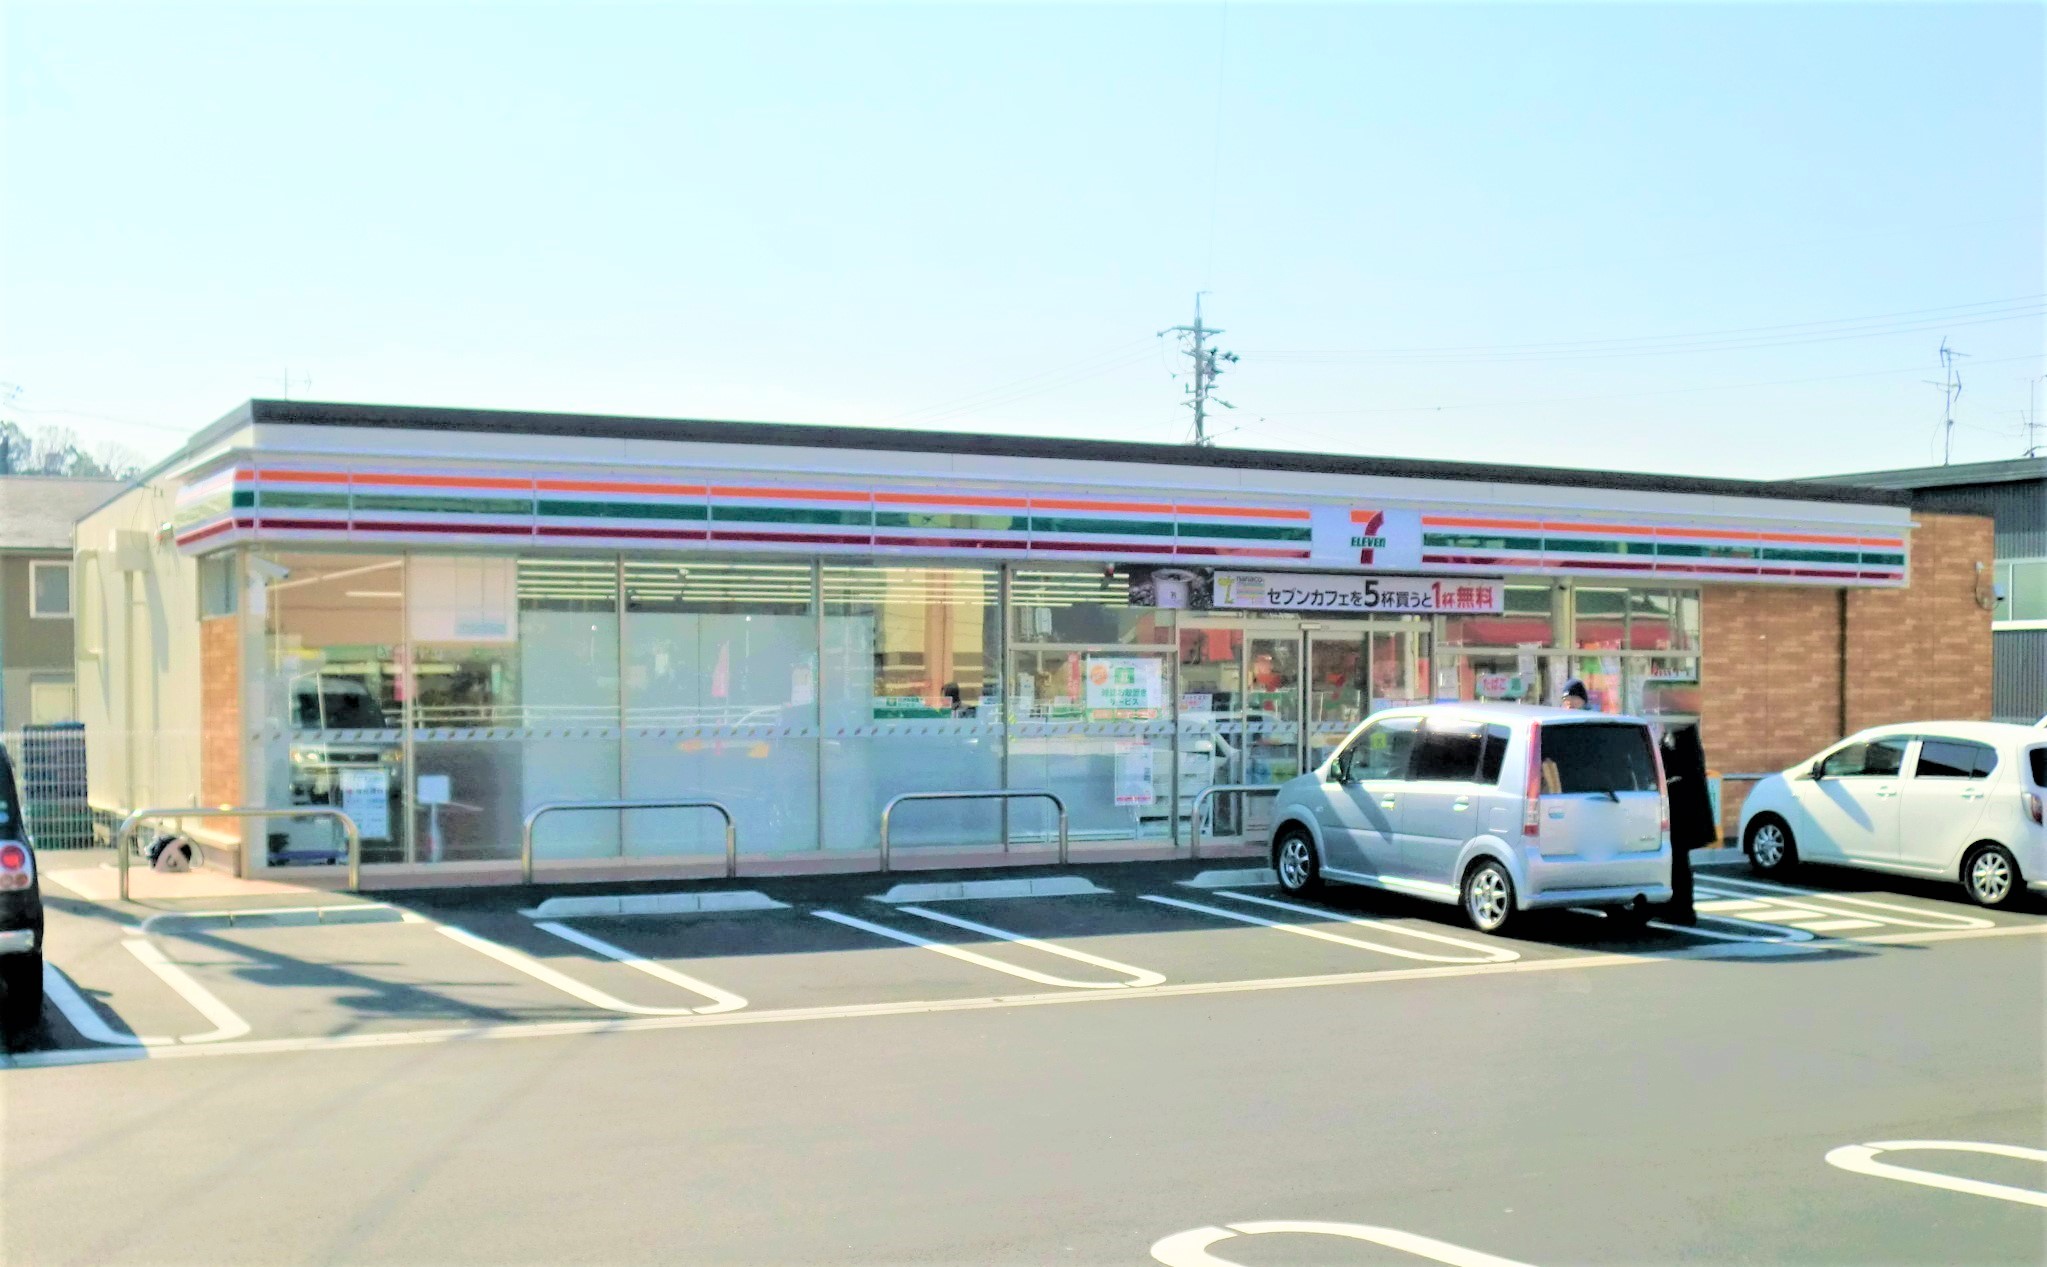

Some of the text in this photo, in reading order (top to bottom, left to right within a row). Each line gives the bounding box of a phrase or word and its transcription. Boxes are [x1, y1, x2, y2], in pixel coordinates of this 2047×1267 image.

[1350, 510, 1384, 564] 7
[1267, 579, 1493, 609] セブンカフェを5杯買うと1杯無料
